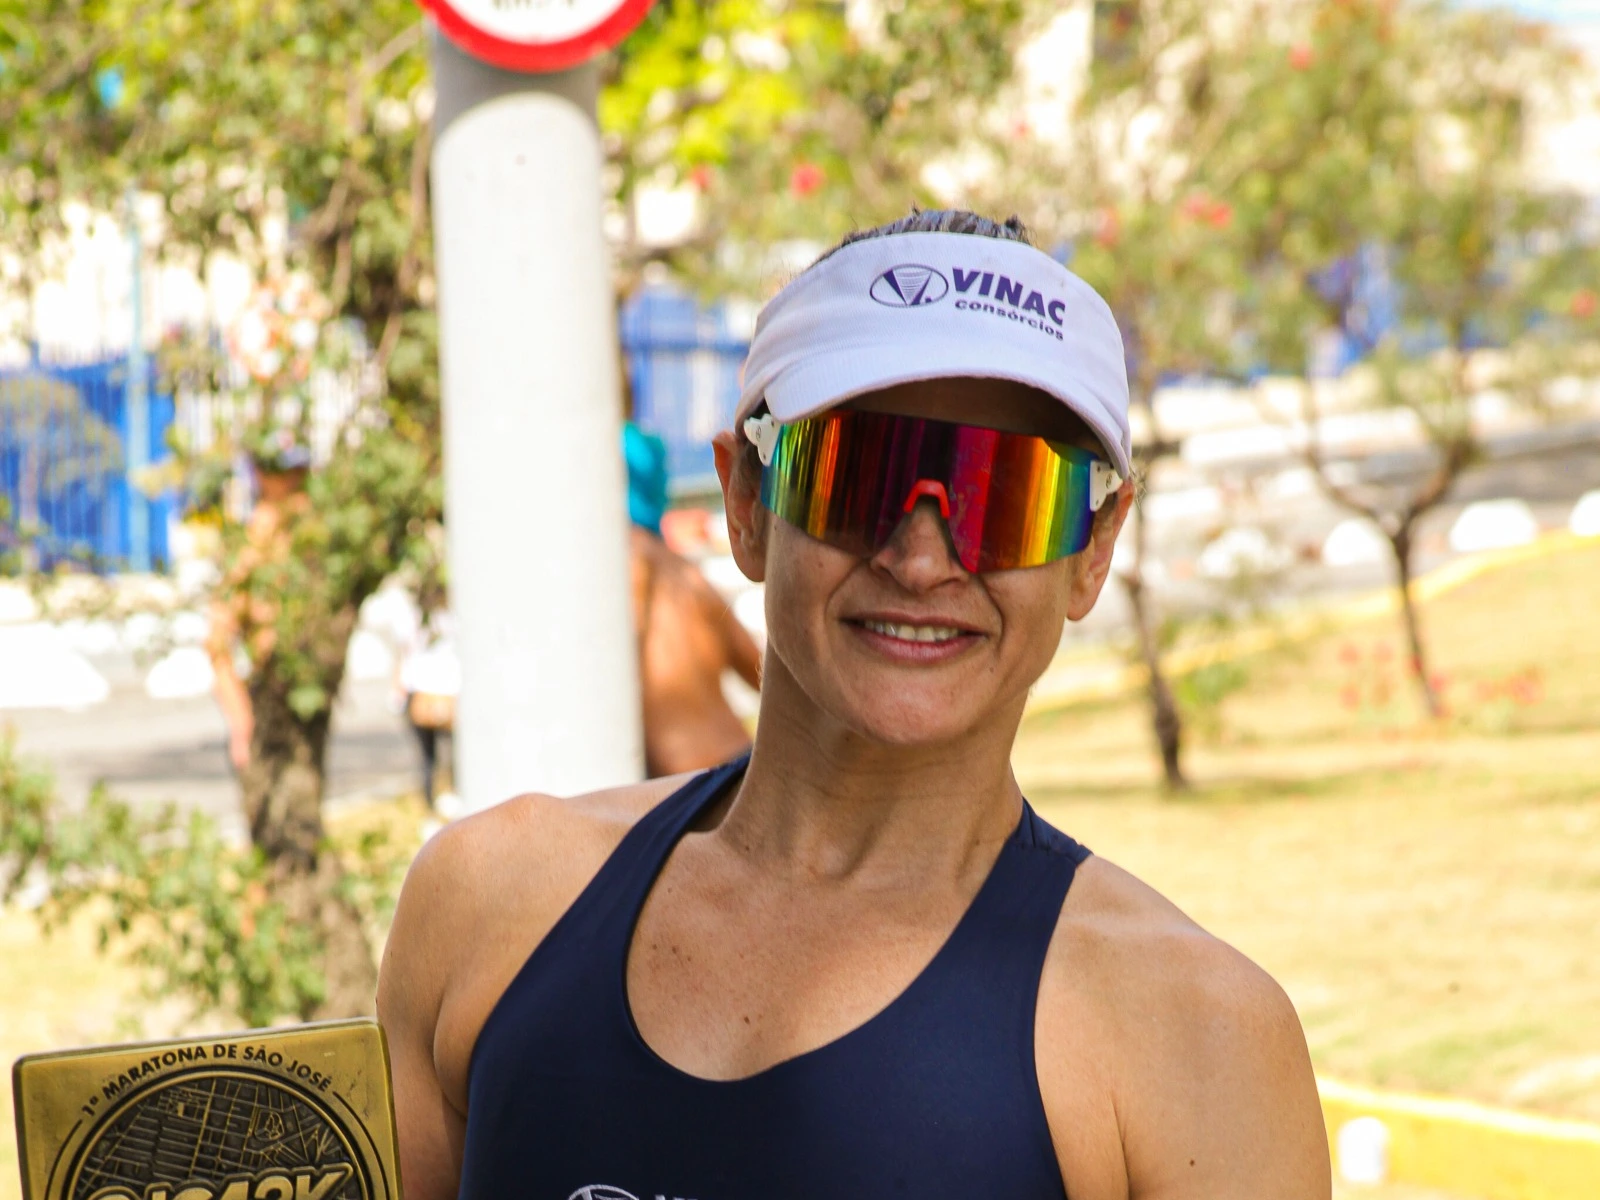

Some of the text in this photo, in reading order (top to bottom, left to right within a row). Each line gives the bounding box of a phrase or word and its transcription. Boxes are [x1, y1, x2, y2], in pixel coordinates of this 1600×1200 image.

[952, 267, 1066, 326] VINAC
[955, 299, 1064, 341] consórcios
[103, 1045, 207, 1101] MARATONA
[212, 1044, 237, 1059] DE
[243, 1045, 283, 1067] SÃO
[286, 1059, 333, 1092] JOSÉ
